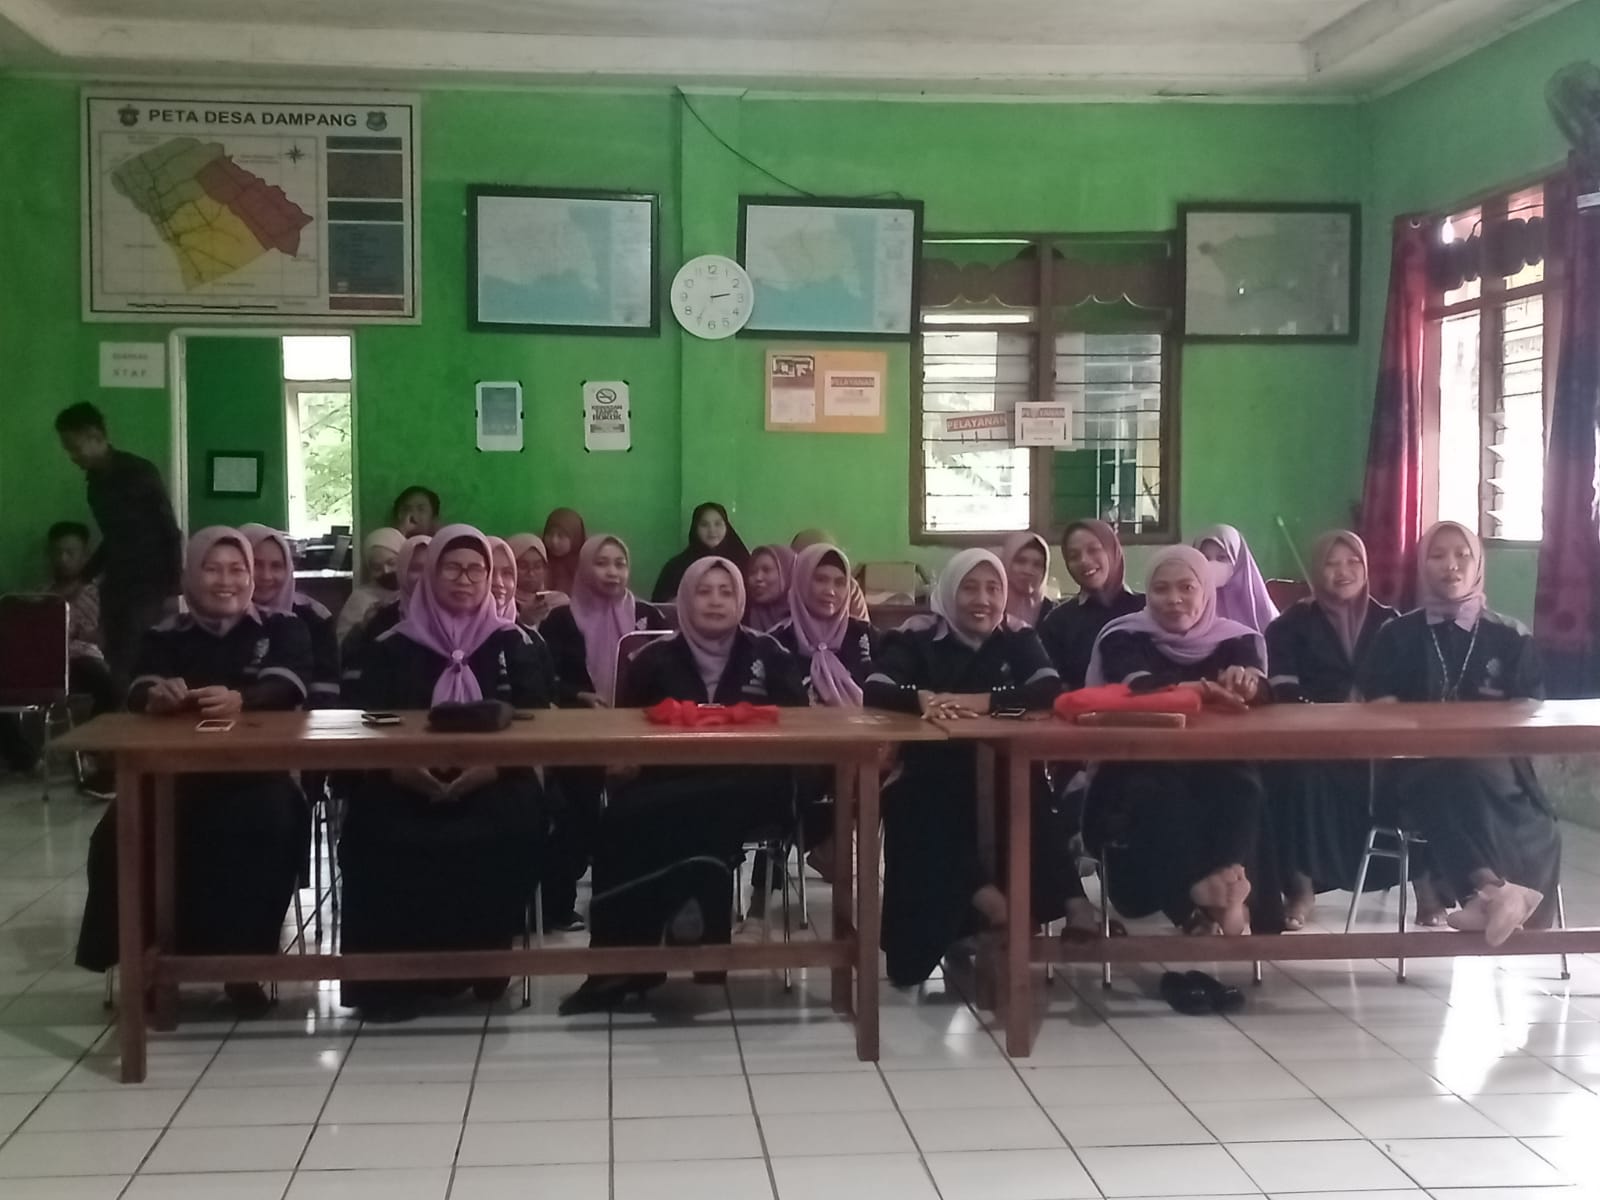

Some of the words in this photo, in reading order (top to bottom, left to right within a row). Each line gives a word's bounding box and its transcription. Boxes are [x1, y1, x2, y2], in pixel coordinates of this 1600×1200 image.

[149, 109, 199, 124] PETA
[204, 110, 257, 125] DESA
[262, 112, 357, 127] DAMPANG
[708, 264, 718, 274] 12
[732, 278, 740, 288] 2
[684, 305, 692, 315] 8
[732, 308, 739, 316] 4
[708, 320, 716, 329] 6
